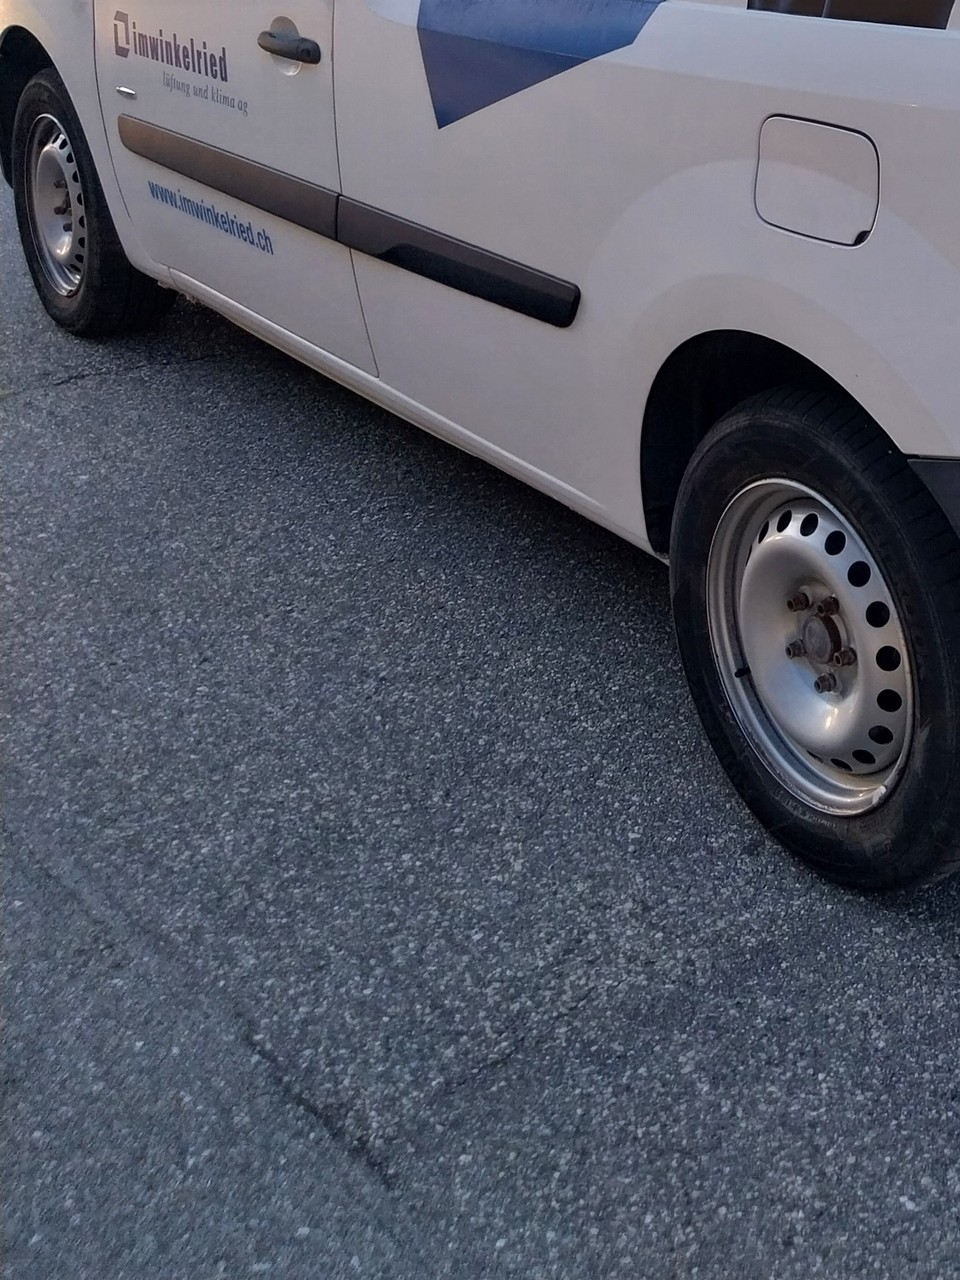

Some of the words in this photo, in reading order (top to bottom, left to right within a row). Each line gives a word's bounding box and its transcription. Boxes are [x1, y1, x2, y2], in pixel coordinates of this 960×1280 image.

[132, 21, 229, 83] imwinkelried
[162, 70, 191, 98] lüftung
[193, 83, 209, 100] und
[210, 85, 236, 109] klima
[237, 98, 249, 117] ag
[147, 180, 275, 256] www.imwinkelried.ch
